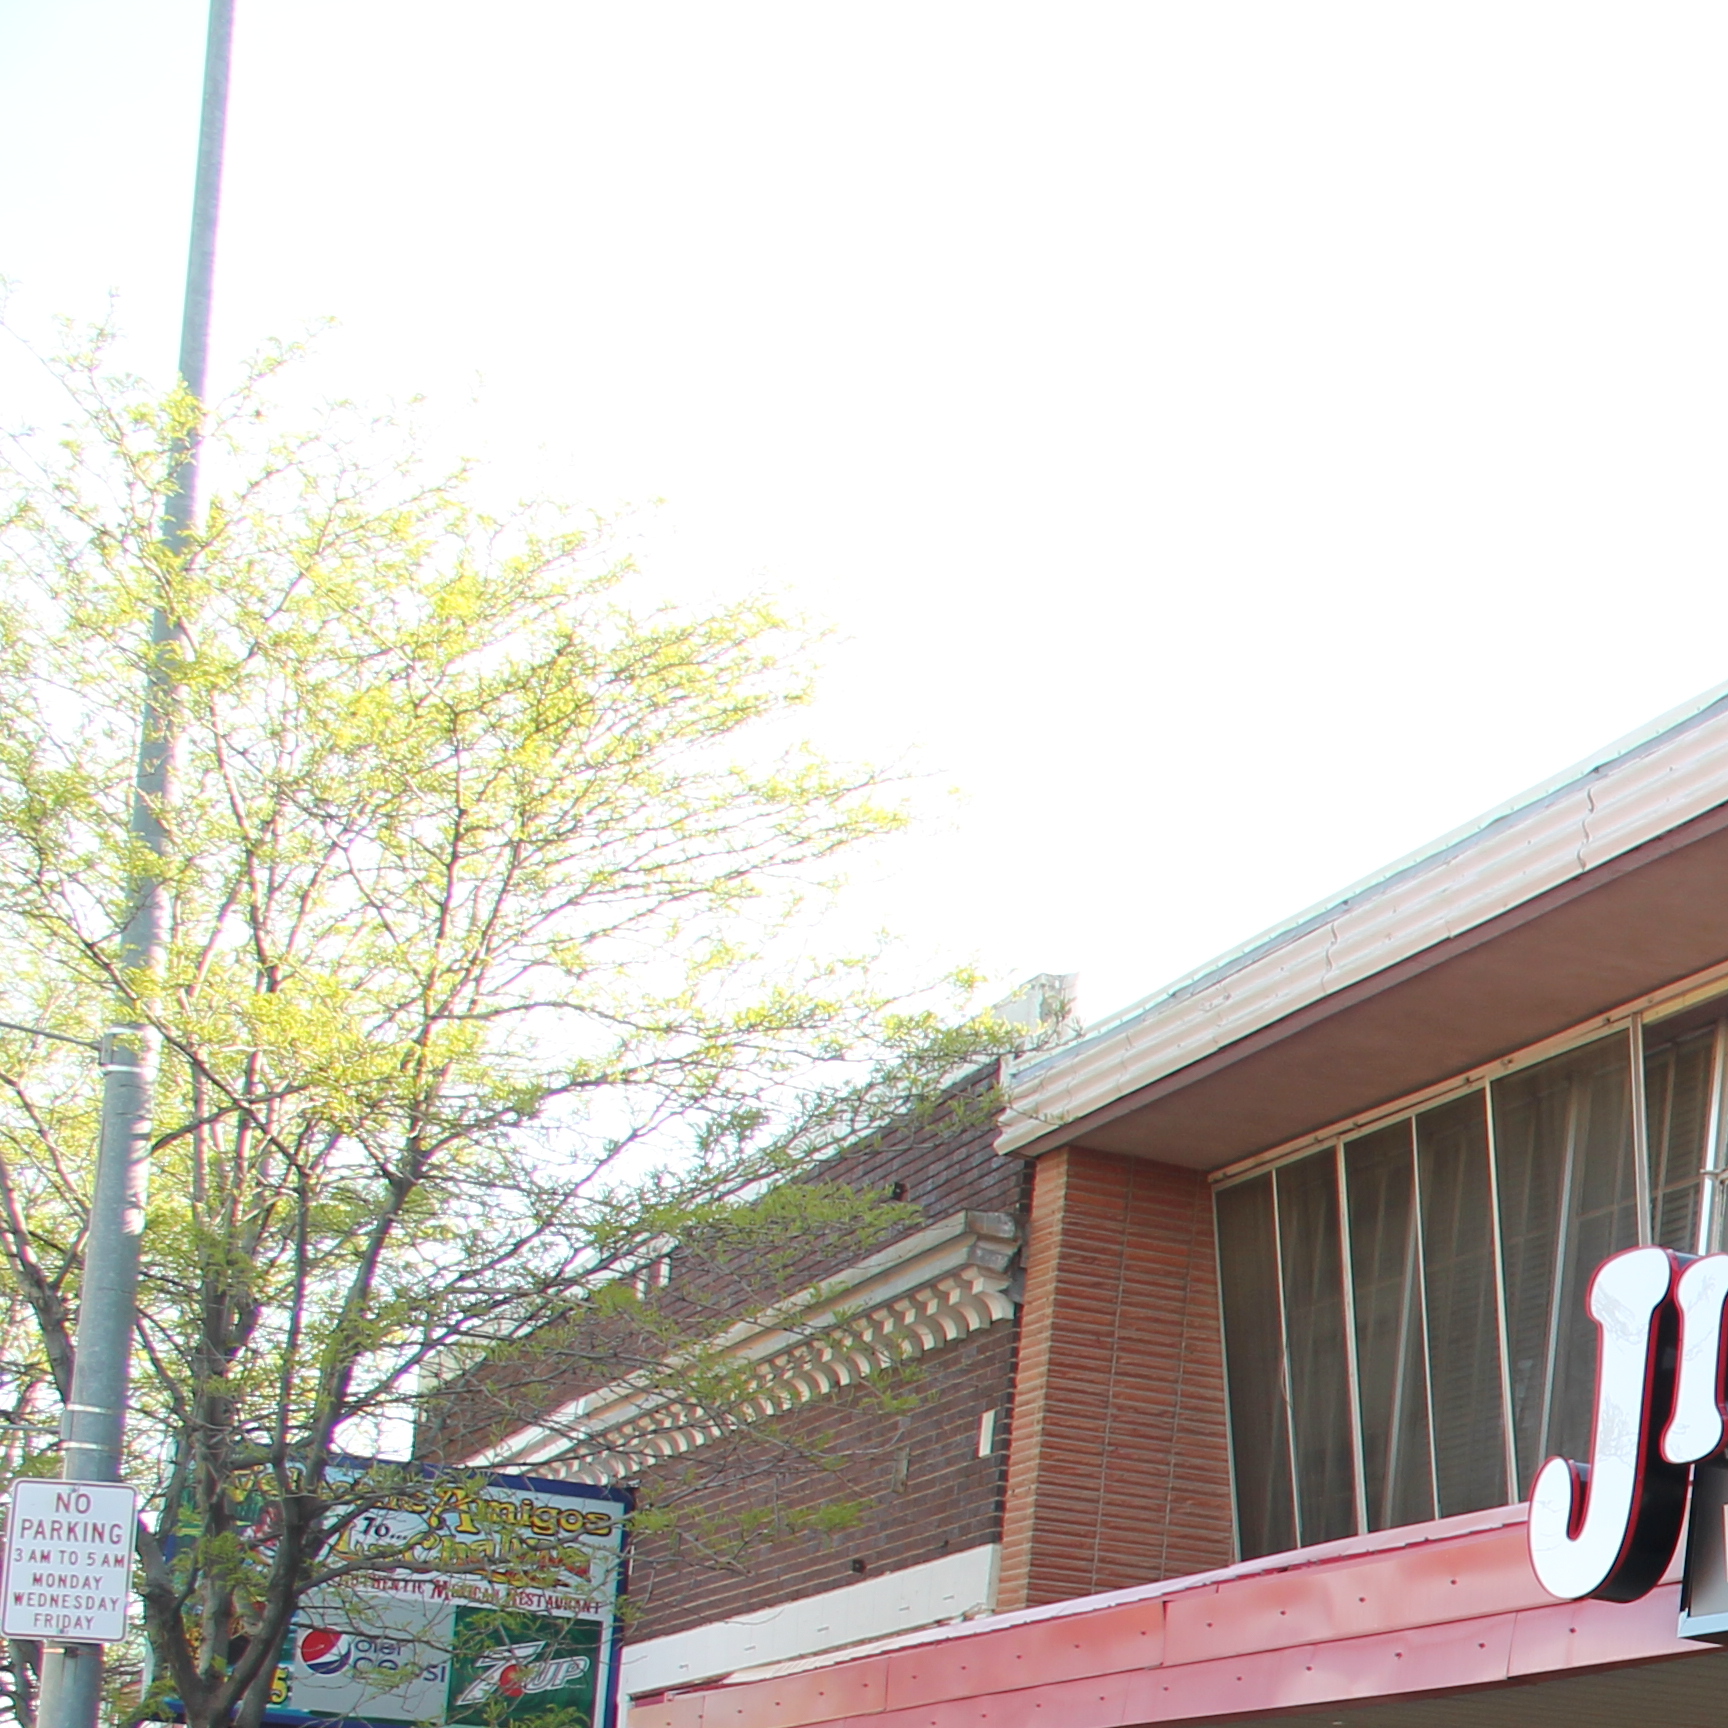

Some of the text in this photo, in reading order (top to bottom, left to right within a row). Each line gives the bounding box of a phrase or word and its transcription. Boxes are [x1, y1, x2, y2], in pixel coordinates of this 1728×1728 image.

[55, 1492, 92, 1514] NO
[20, 1519, 123, 1545] PARKING
[14, 1548, 125, 1568] 3 AM TO 5 AM
[32, 1572, 103, 1590] MONDAY
[14, 1592, 120, 1612] WEDNESDAY
[34, 1613, 94, 1630] FRIDAY
